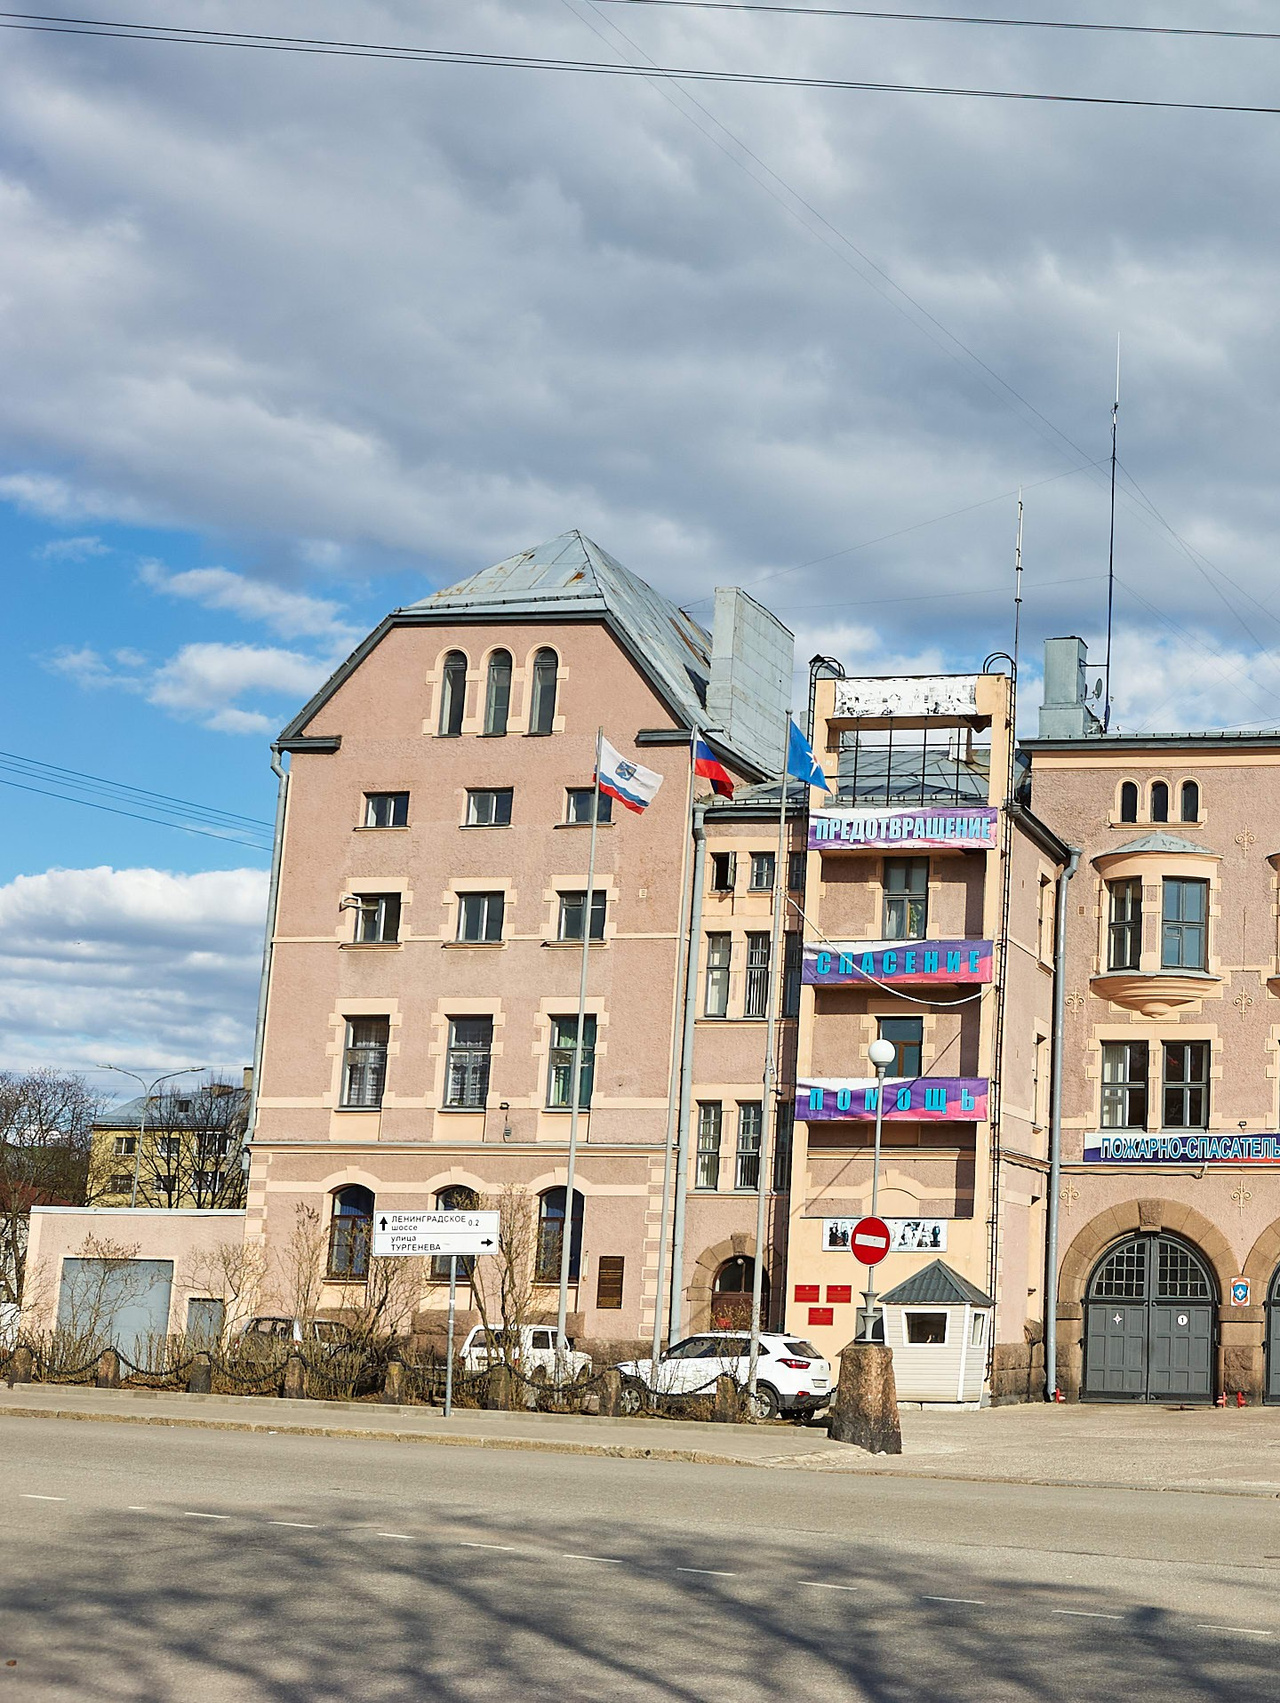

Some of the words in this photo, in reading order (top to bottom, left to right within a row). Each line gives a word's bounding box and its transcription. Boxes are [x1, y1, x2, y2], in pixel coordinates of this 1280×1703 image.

[815, 817, 991, 843] ПРЕДОТВРАЩЕНИЕ
[816, 950, 980, 975] СПАСЕНИЕ
[809, 1087, 976, 1115] ПОМОЩЬ
[391, 1215, 466, 1223] ЛЕНИНГРАДСКОЕ
[391, 1243, 441, 1251] ТУРГЕНЕВА
